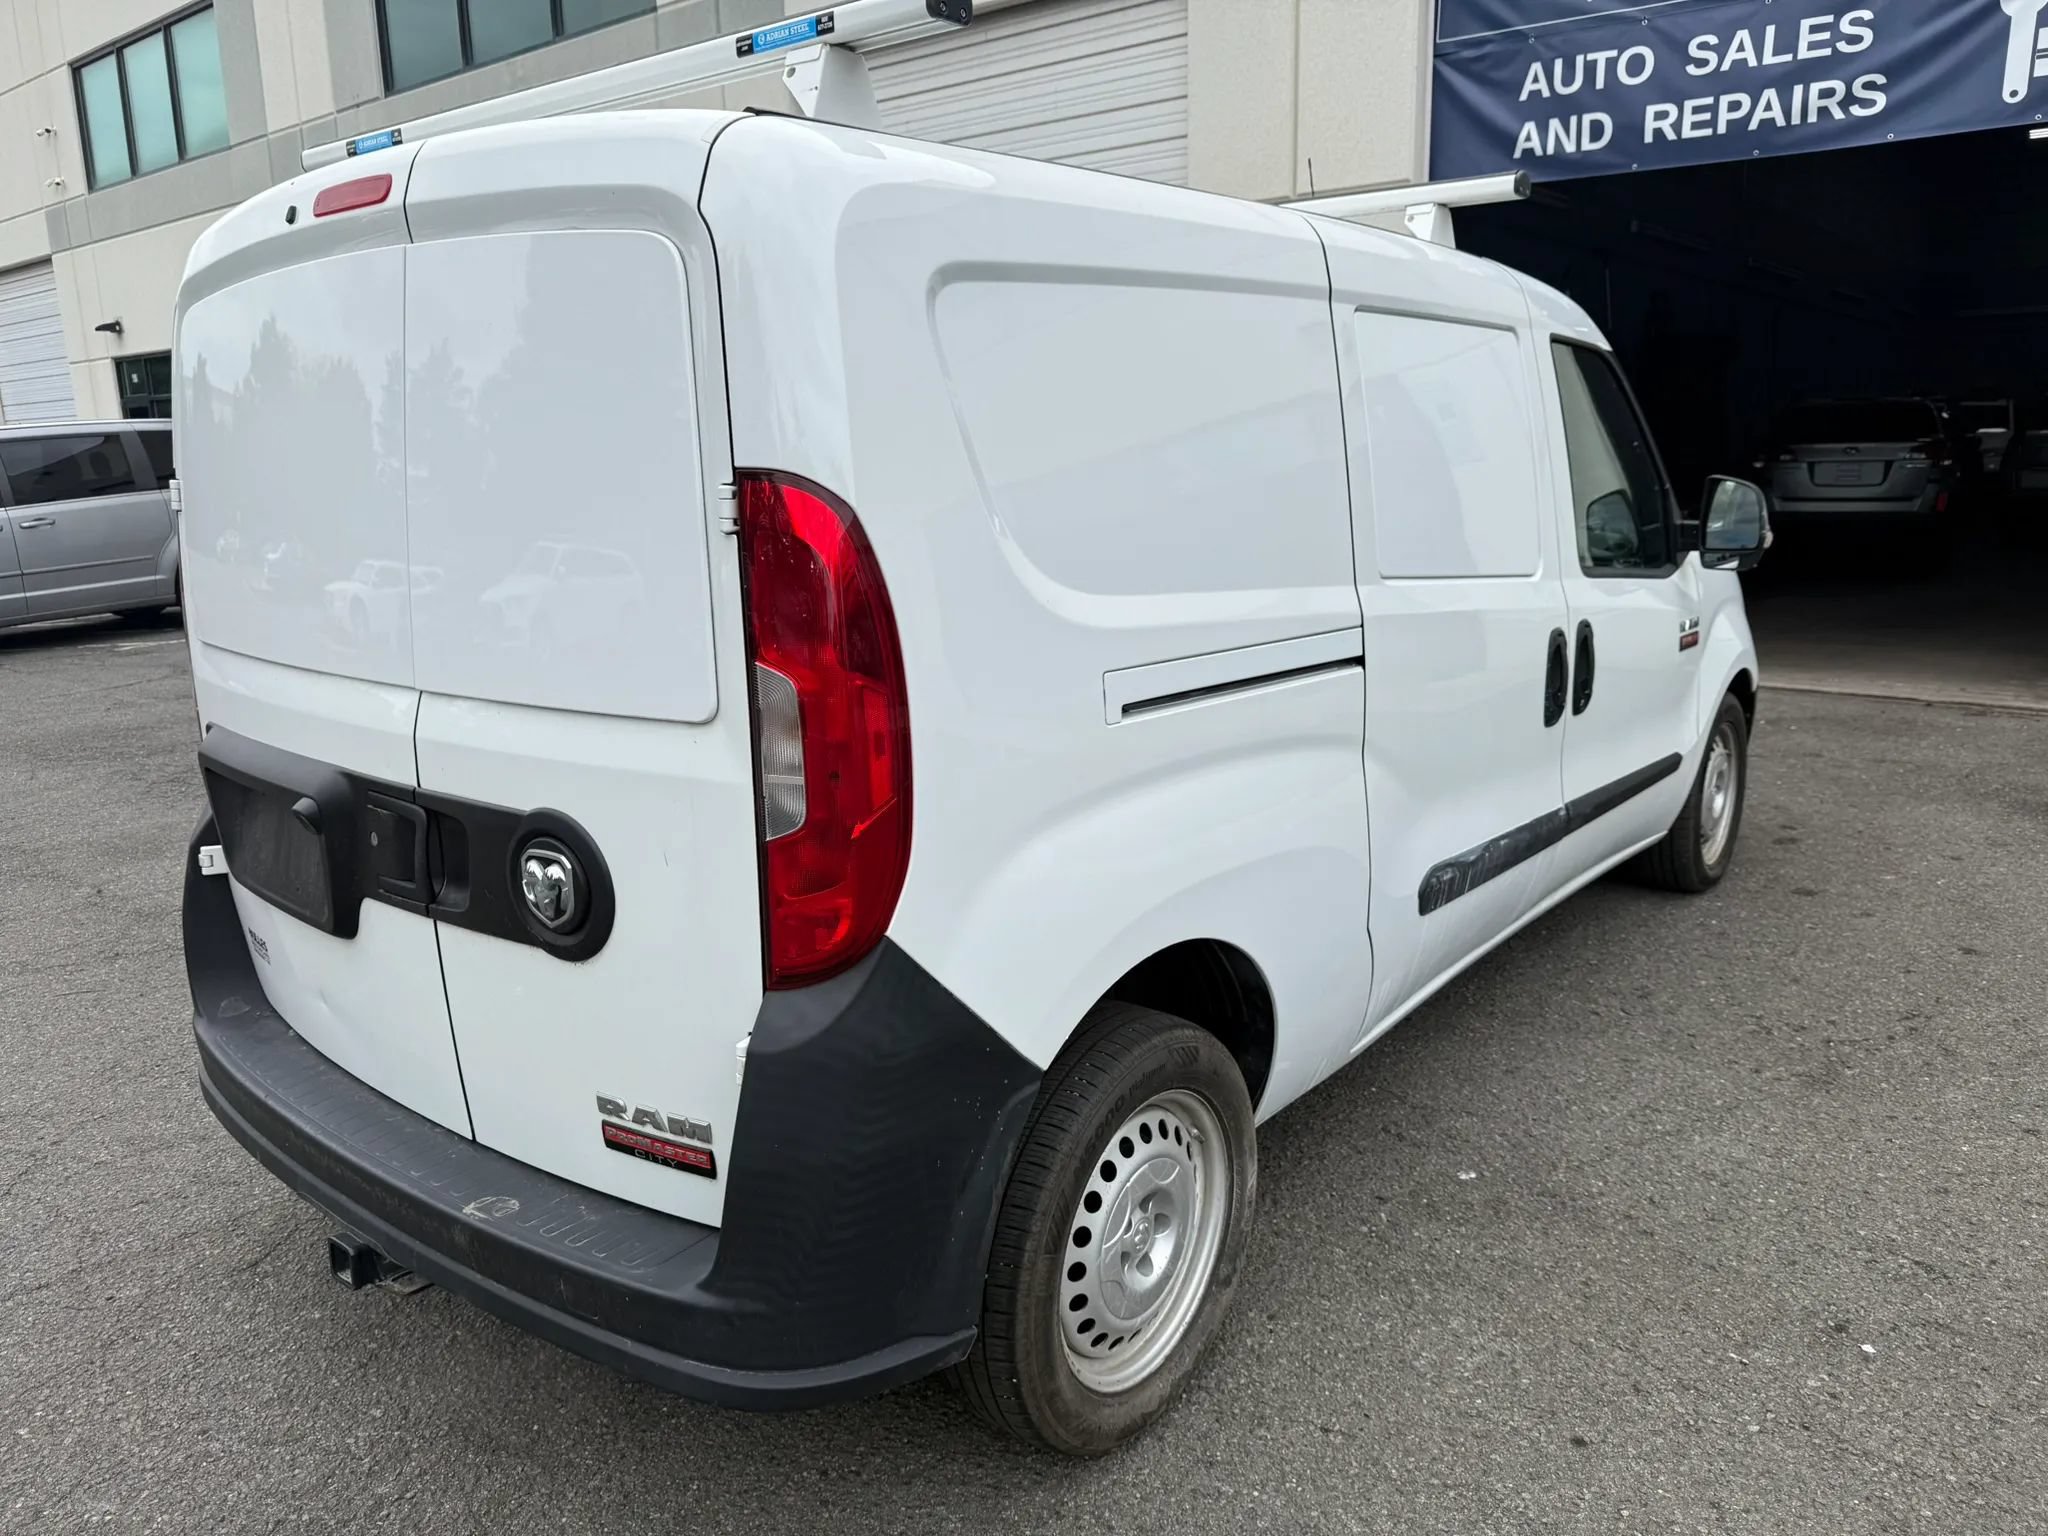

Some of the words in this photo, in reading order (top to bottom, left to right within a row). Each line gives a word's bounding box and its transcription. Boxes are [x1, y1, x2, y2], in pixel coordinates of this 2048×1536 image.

[766, 29, 790, 42] ADRIAN
[790, 23, 809, 35] STEEL
[1519, 45, 1655, 102] AUTO
[1685, 9, 1875, 76] SALES
[1513, 112, 1613, 159] AND
[1643, 73, 1888, 144] REPAIRS
[596, 1091, 713, 1145] RAM
[605, 1126, 709, 1165] PROMASTER
[634, 1149, 678, 1168] CITY
